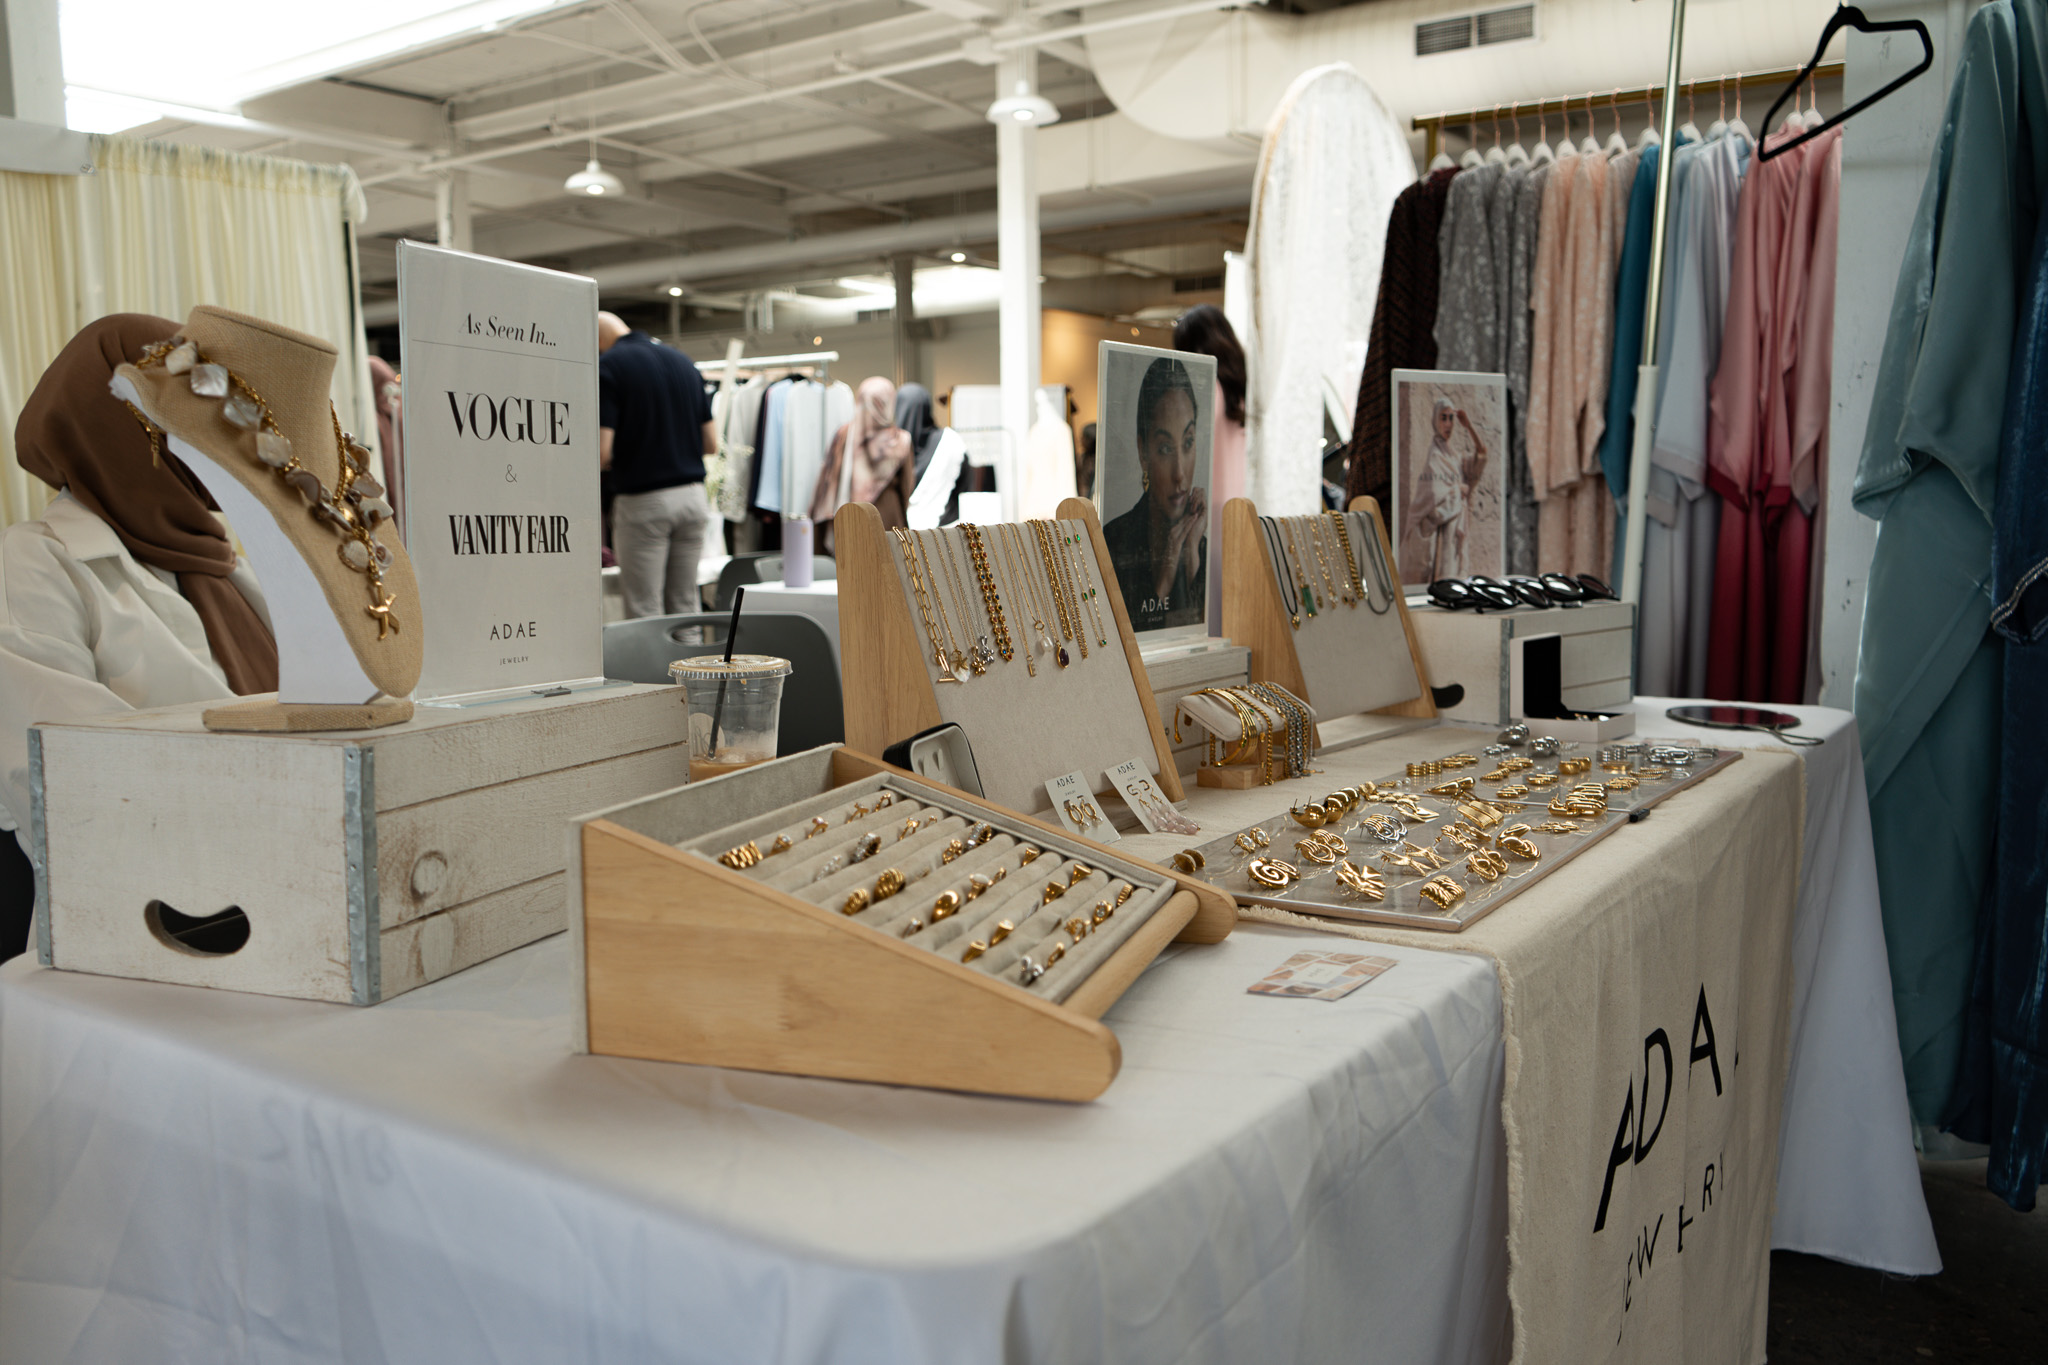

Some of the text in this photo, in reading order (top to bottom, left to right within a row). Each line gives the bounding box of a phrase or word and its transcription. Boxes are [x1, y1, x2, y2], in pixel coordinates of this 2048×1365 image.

[458, 312, 557, 347] As Seen In...
[444, 390, 571, 446] VOGUE
[505, 463, 518, 483] &
[448, 514, 571, 556] VANITY FAIR
[1140, 597, 1170, 613] ADAE
[490, 621, 537, 641] ADAE
[499, 655, 529, 666] JEWELRY
[1117, 761, 1136, 776] ADAE
[1056, 774, 1075, 788] ADAE
[1593, 981, 1739, 1234] ADA
